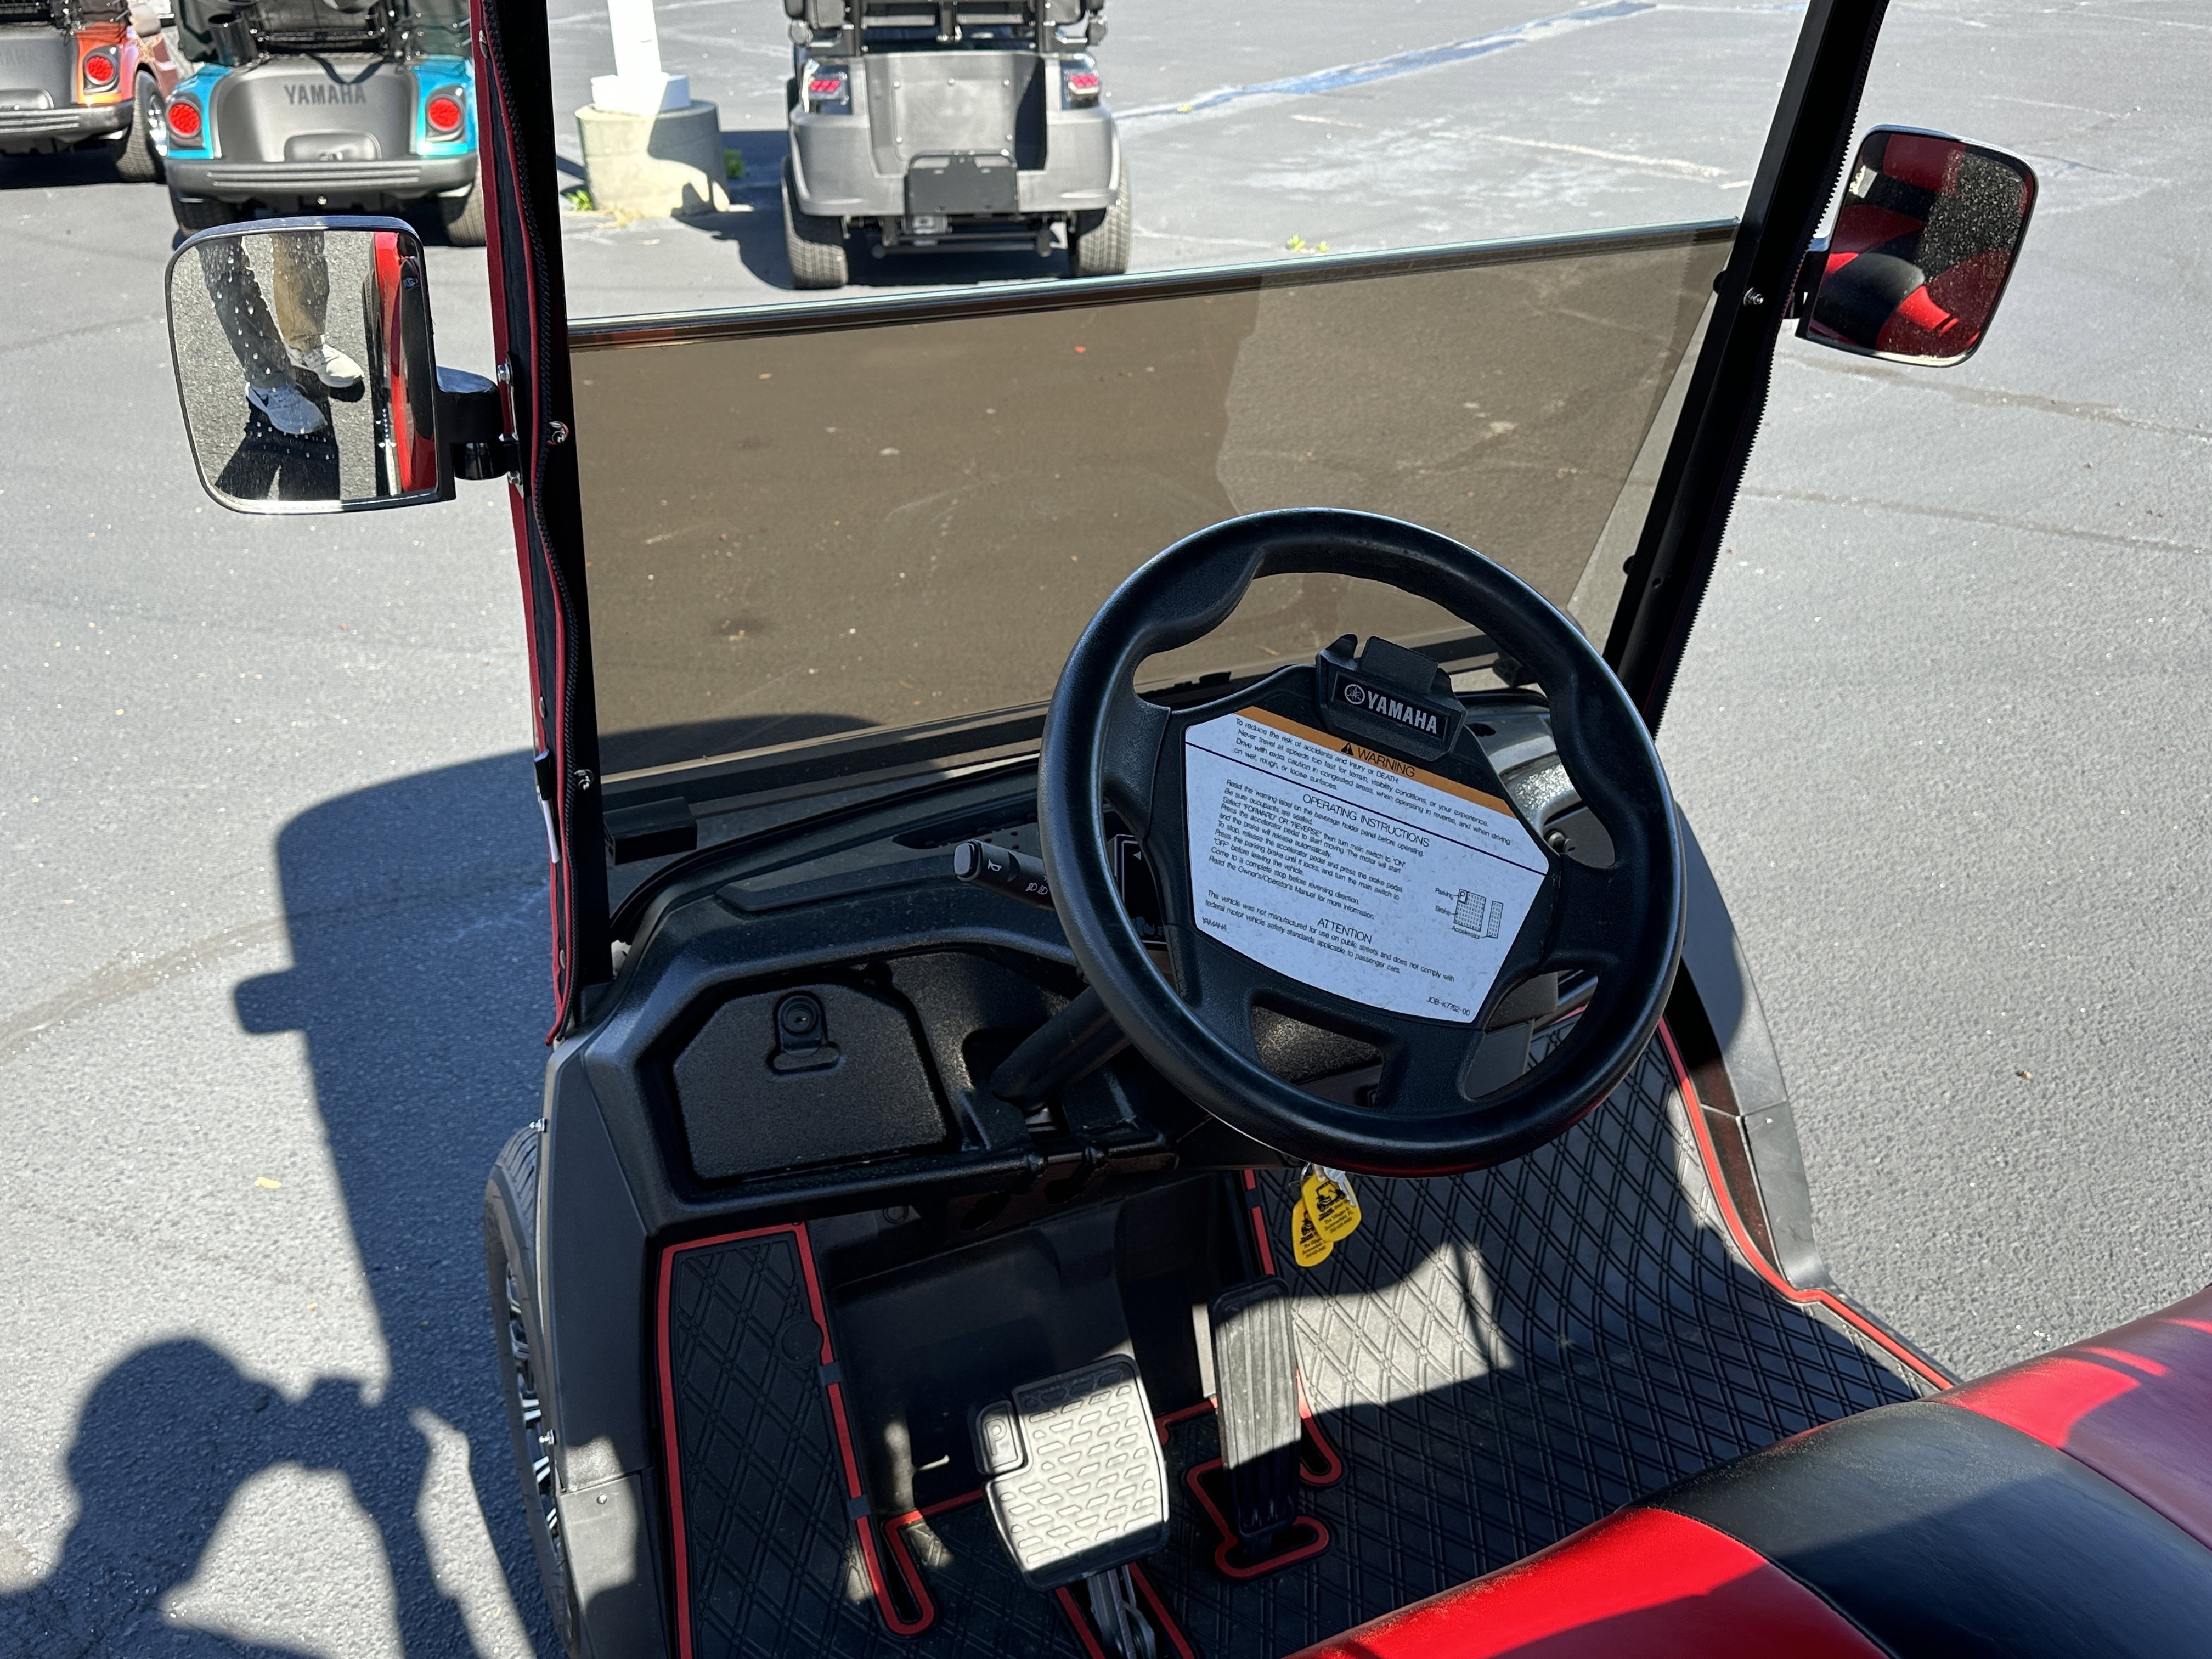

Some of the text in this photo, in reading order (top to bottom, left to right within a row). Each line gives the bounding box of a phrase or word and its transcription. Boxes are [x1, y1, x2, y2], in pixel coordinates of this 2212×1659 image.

[284, 83, 366, 105] YAMAHA
[1368, 691, 1437, 734] YAMAHA
[1357, 748, 1415, 778] WARNING
[1303, 794, 1429, 847] OPERATING INSTRUCTIONS
[1202, 916, 1227, 931] YAMAHA
[1317, 918, 1372, 944] ATTENTION
[985, 1419, 1007, 1456] P
